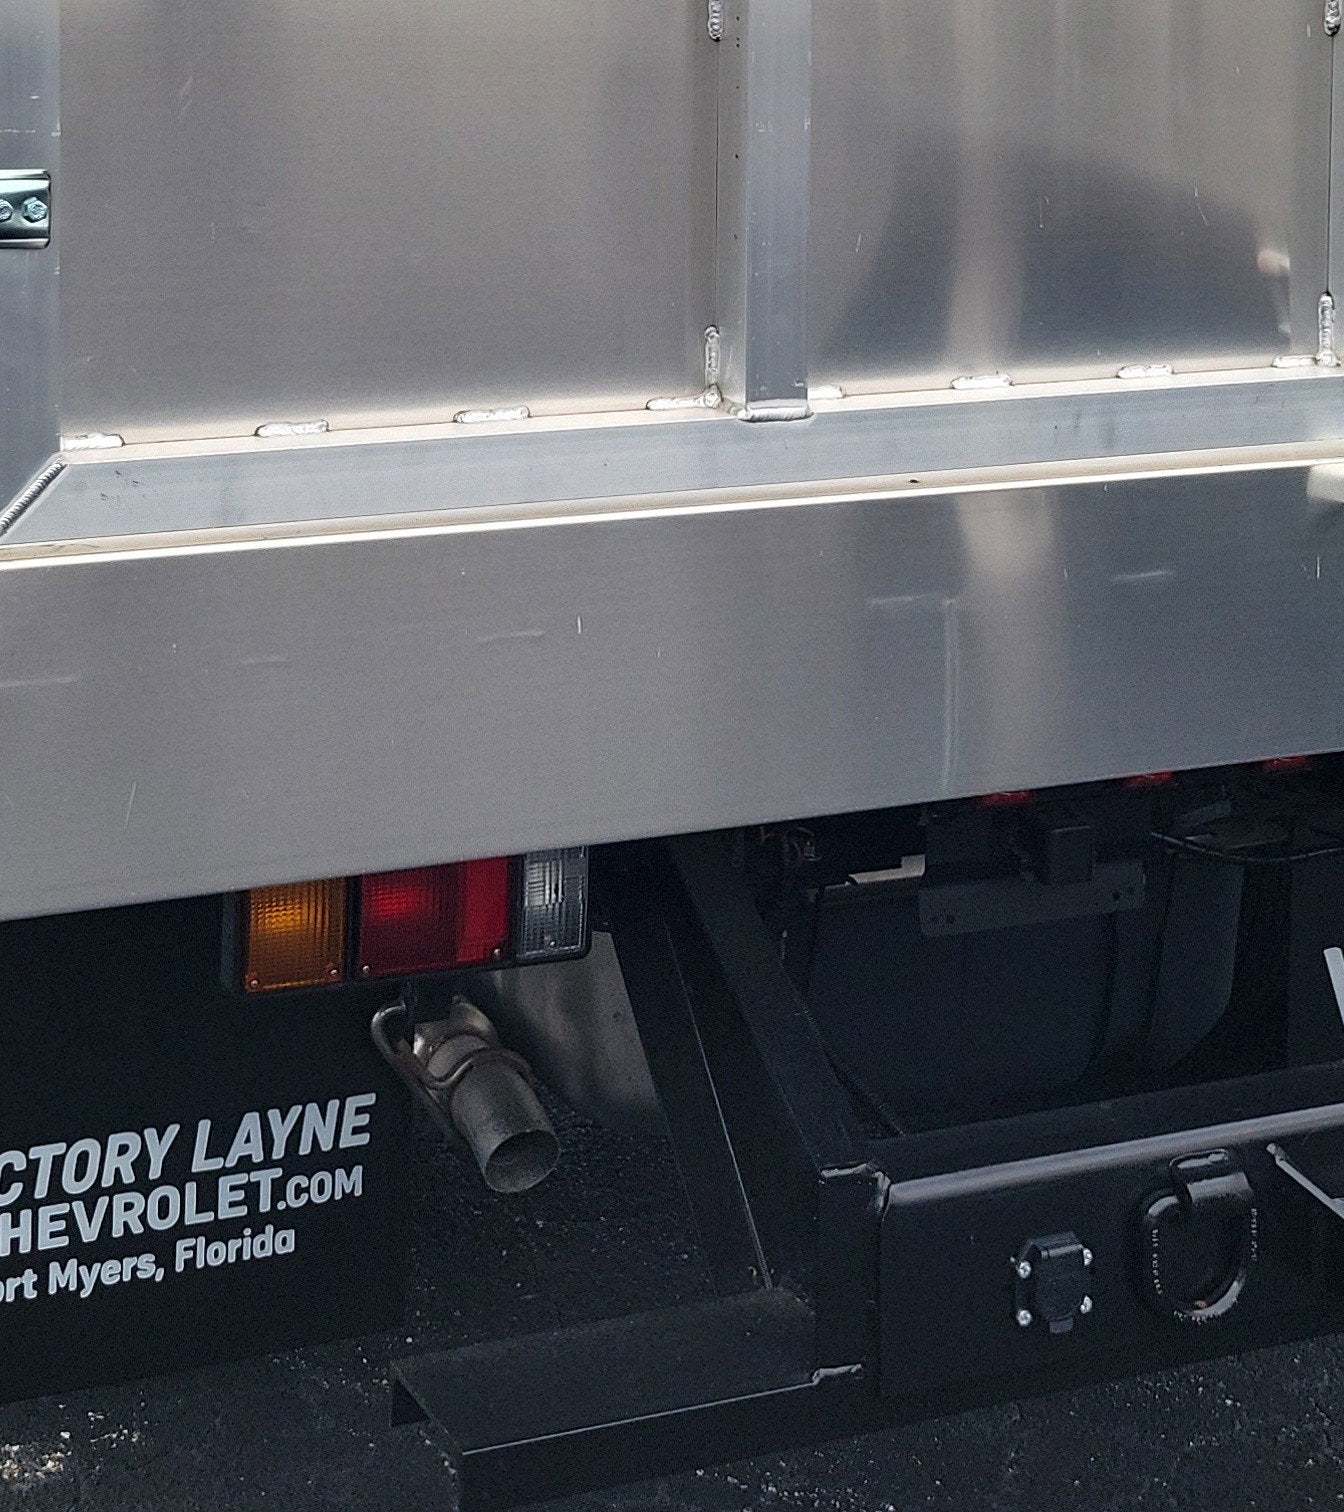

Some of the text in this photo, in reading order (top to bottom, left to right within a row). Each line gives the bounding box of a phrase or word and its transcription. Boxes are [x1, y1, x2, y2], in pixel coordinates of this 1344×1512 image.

[190, 1092, 377, 1171] LAYNE
[47, 1249, 166, 1300] Myers,
[174, 1222, 296, 1273] Florida
